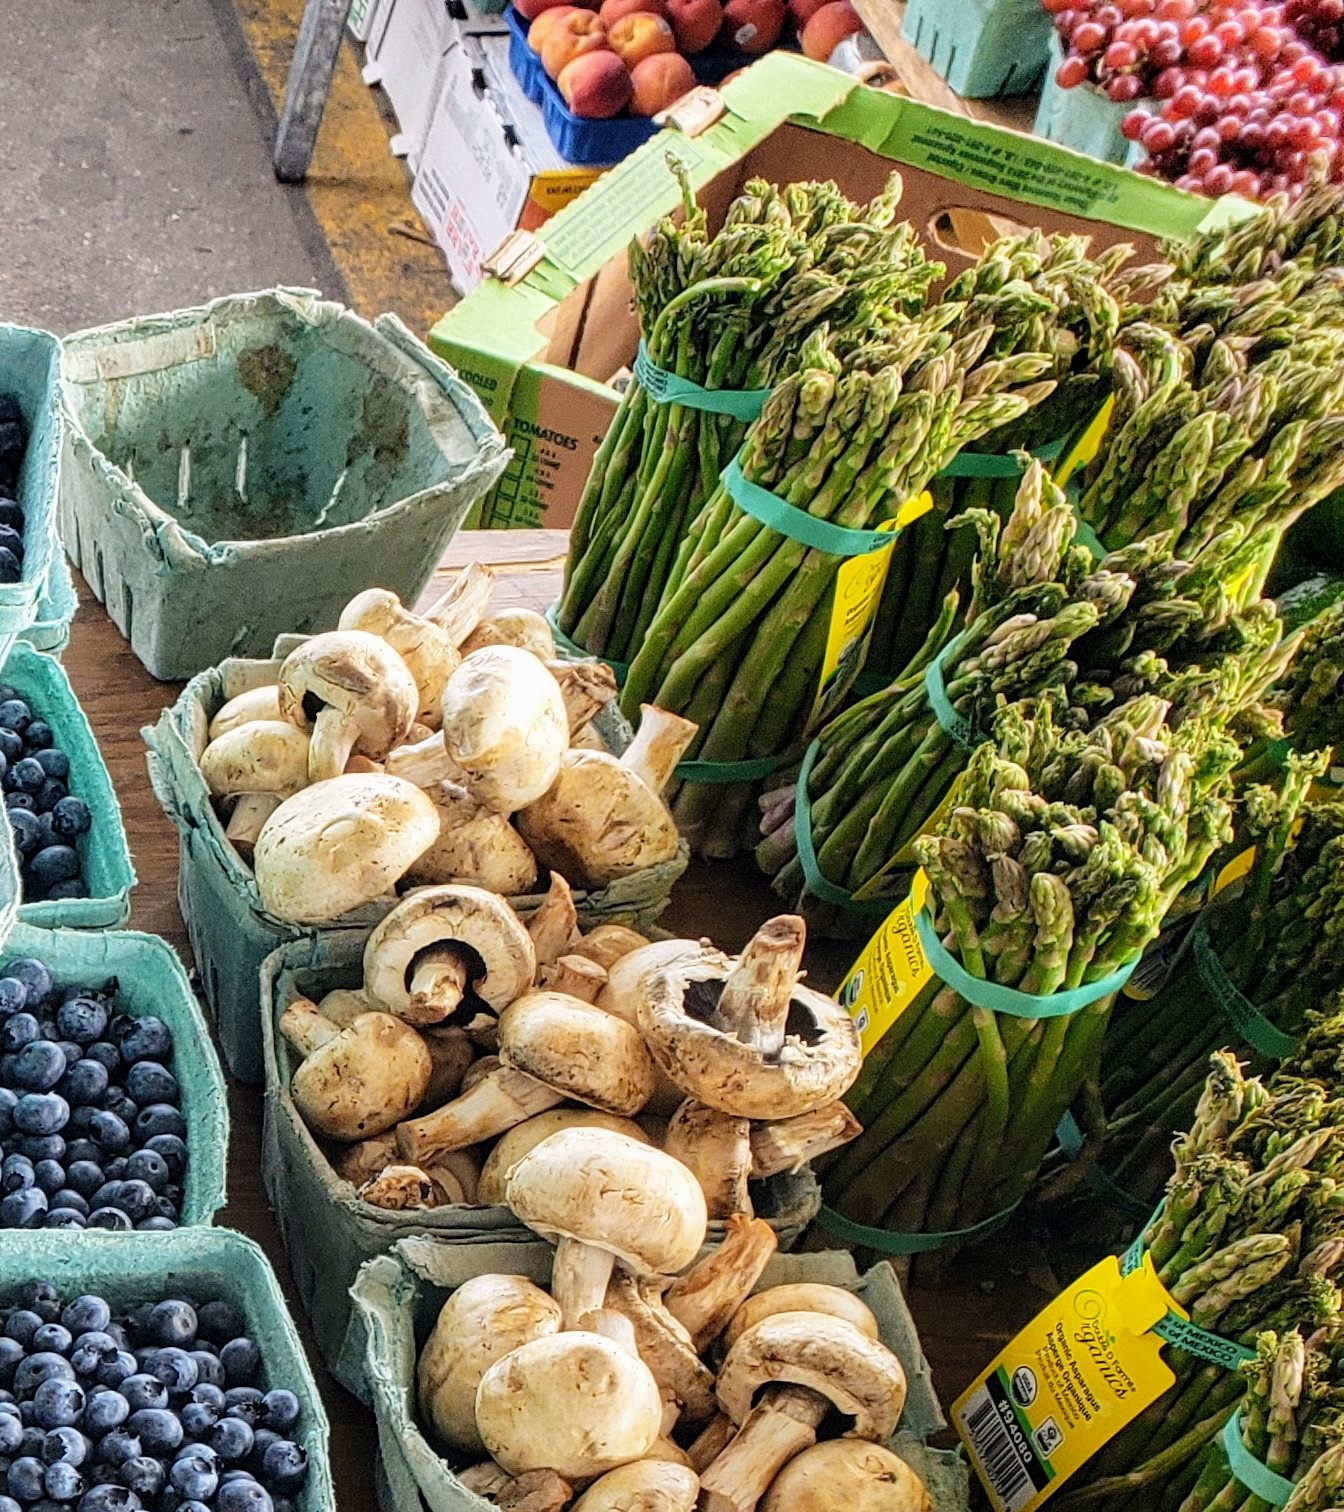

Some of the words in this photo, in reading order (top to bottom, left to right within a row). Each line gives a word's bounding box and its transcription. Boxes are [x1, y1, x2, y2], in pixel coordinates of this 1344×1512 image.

[514, 417, 579, 450] TOMATOES
[1182, 1337, 1232, 1361] MEXICO
[1187, 1327, 1238, 1354] MEXICO
[1045, 1332, 1067, 1370] Asperge
[1063, 1370, 1093, 1421] Organique
[1055, 1322, 1075, 1359] Organic
[1068, 1361, 1102, 1411] Asparagus
[997, 1400, 1033, 1463] #94080
